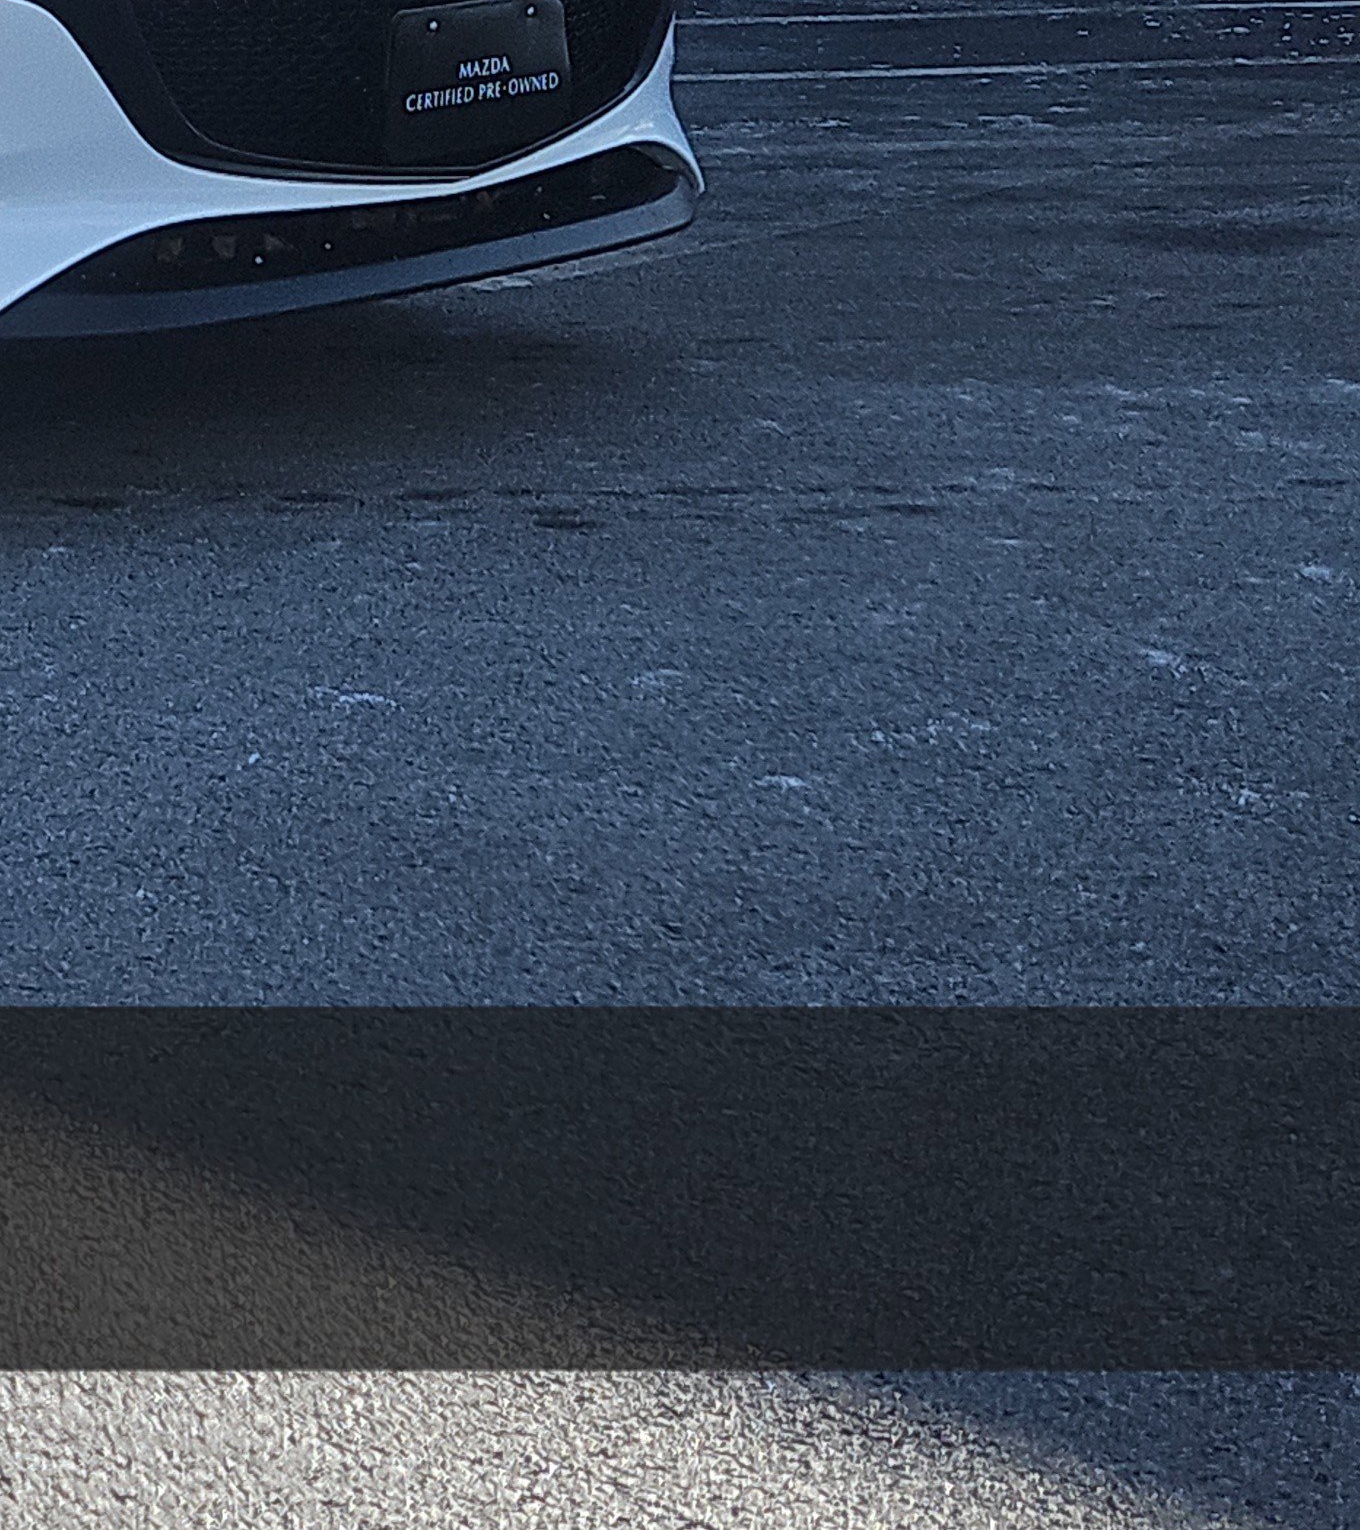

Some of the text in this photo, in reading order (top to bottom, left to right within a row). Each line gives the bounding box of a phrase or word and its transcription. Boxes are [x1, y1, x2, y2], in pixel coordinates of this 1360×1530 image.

[458, 56, 511, 80] MAZDA
[405, 71, 560, 112] CERTIFIED PRE-OWNED
